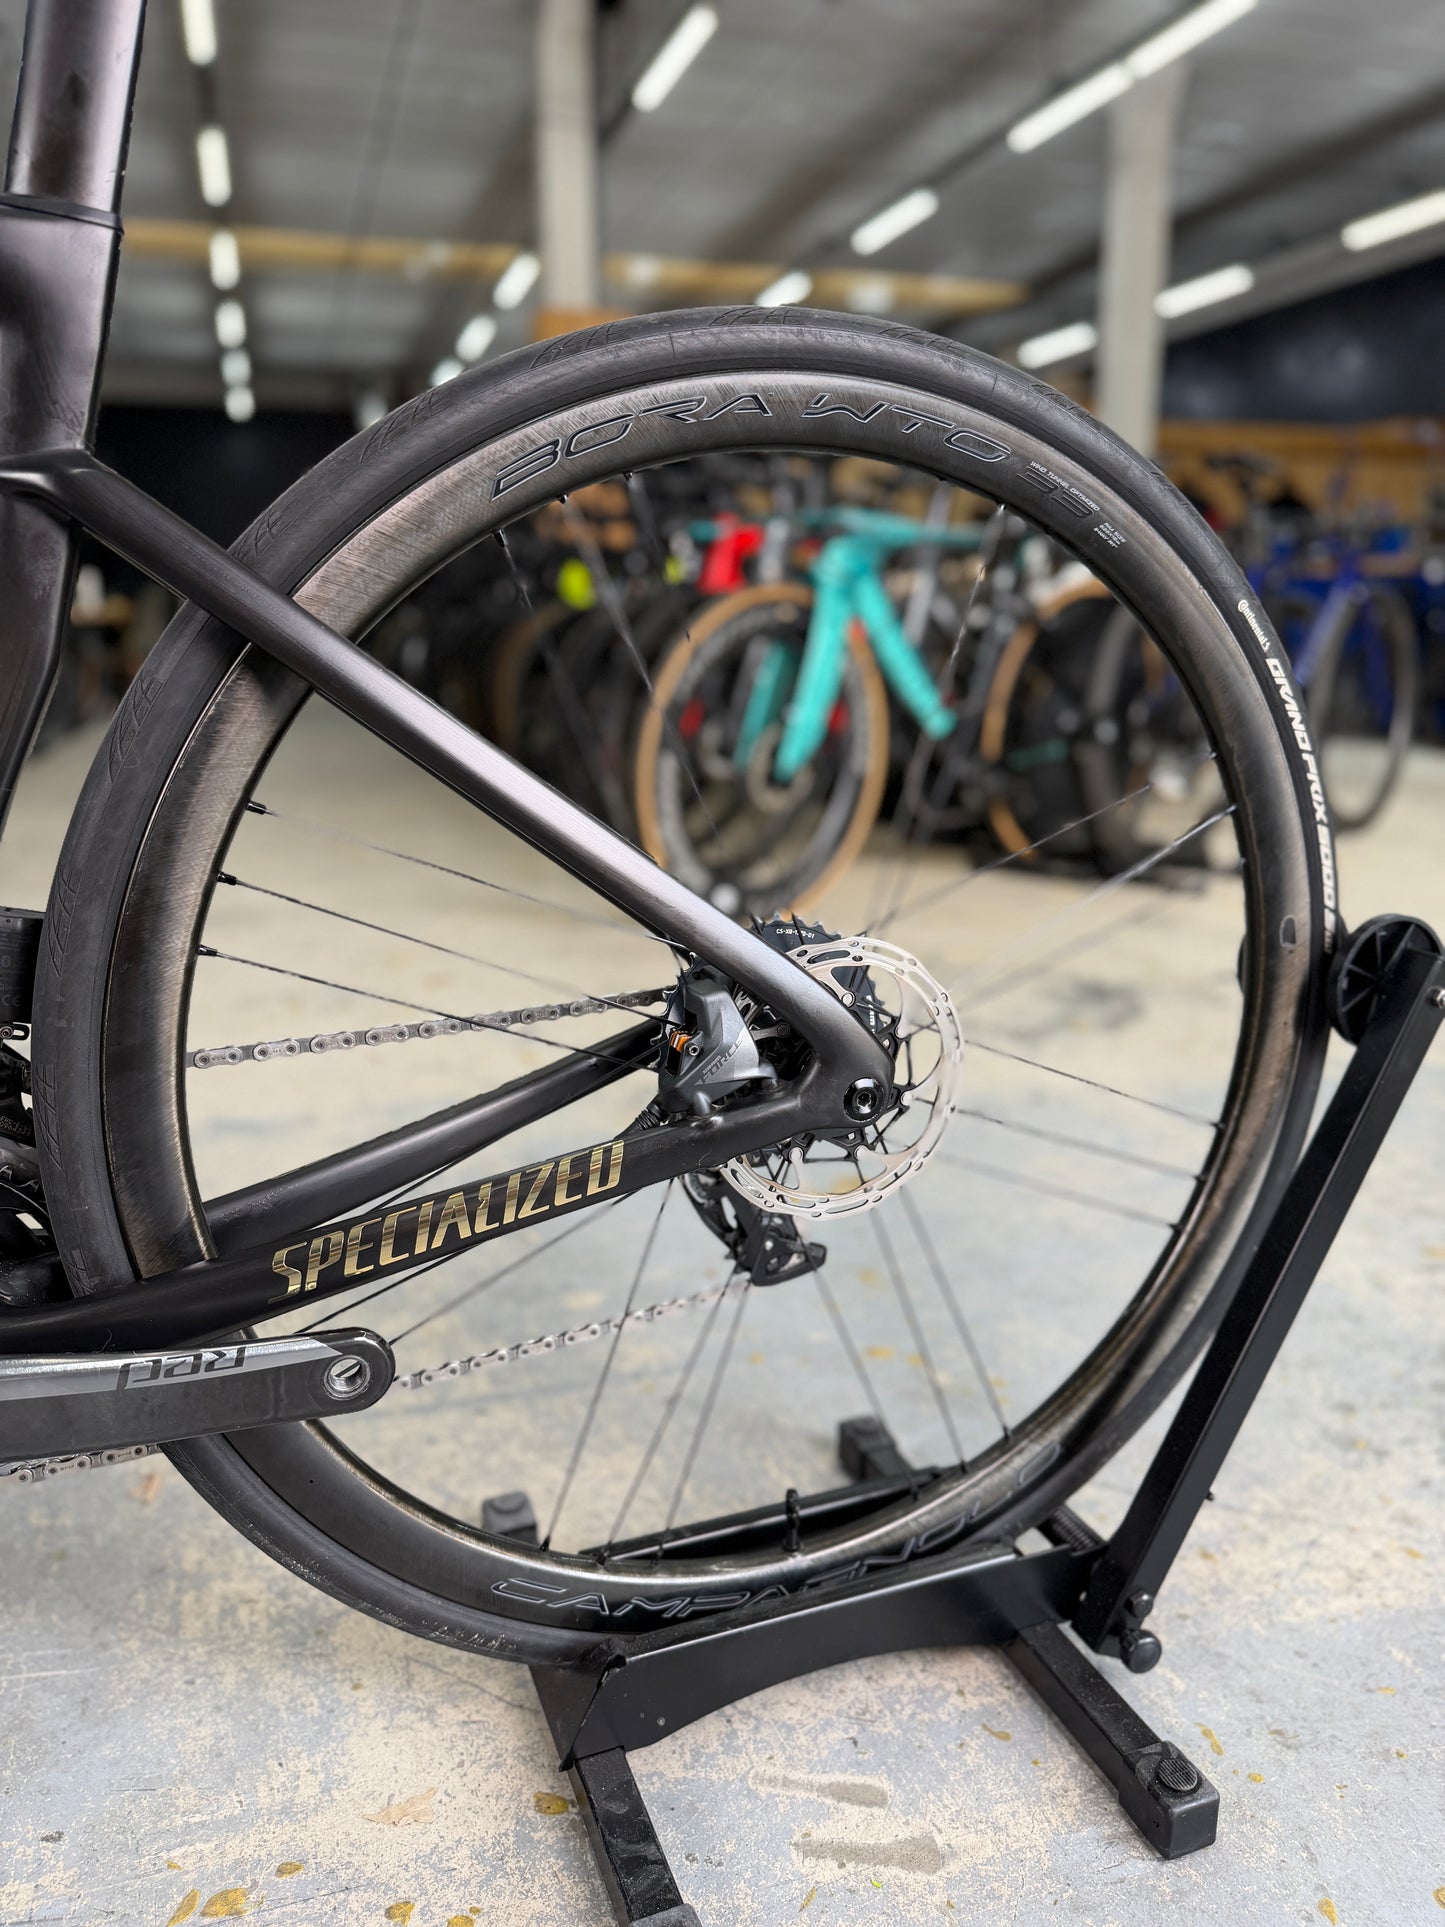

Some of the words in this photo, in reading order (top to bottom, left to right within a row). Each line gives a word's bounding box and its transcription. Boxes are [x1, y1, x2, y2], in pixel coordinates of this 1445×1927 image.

[490, 393, 773, 501] BORA
[801, 393, 1011, 462] WTO
[1030, 461, 1047, 474] WIND
[1047, 471, 1070, 489] TUNNEL
[1238, 599, 1268, 648] Continental
[1265, 658, 1312, 751] GRAND
[1301, 752, 1329, 824] PRIX
[702, 1040, 744, 1084] FORCE
[268, 1139, 625, 1305] SPECIALIZED
